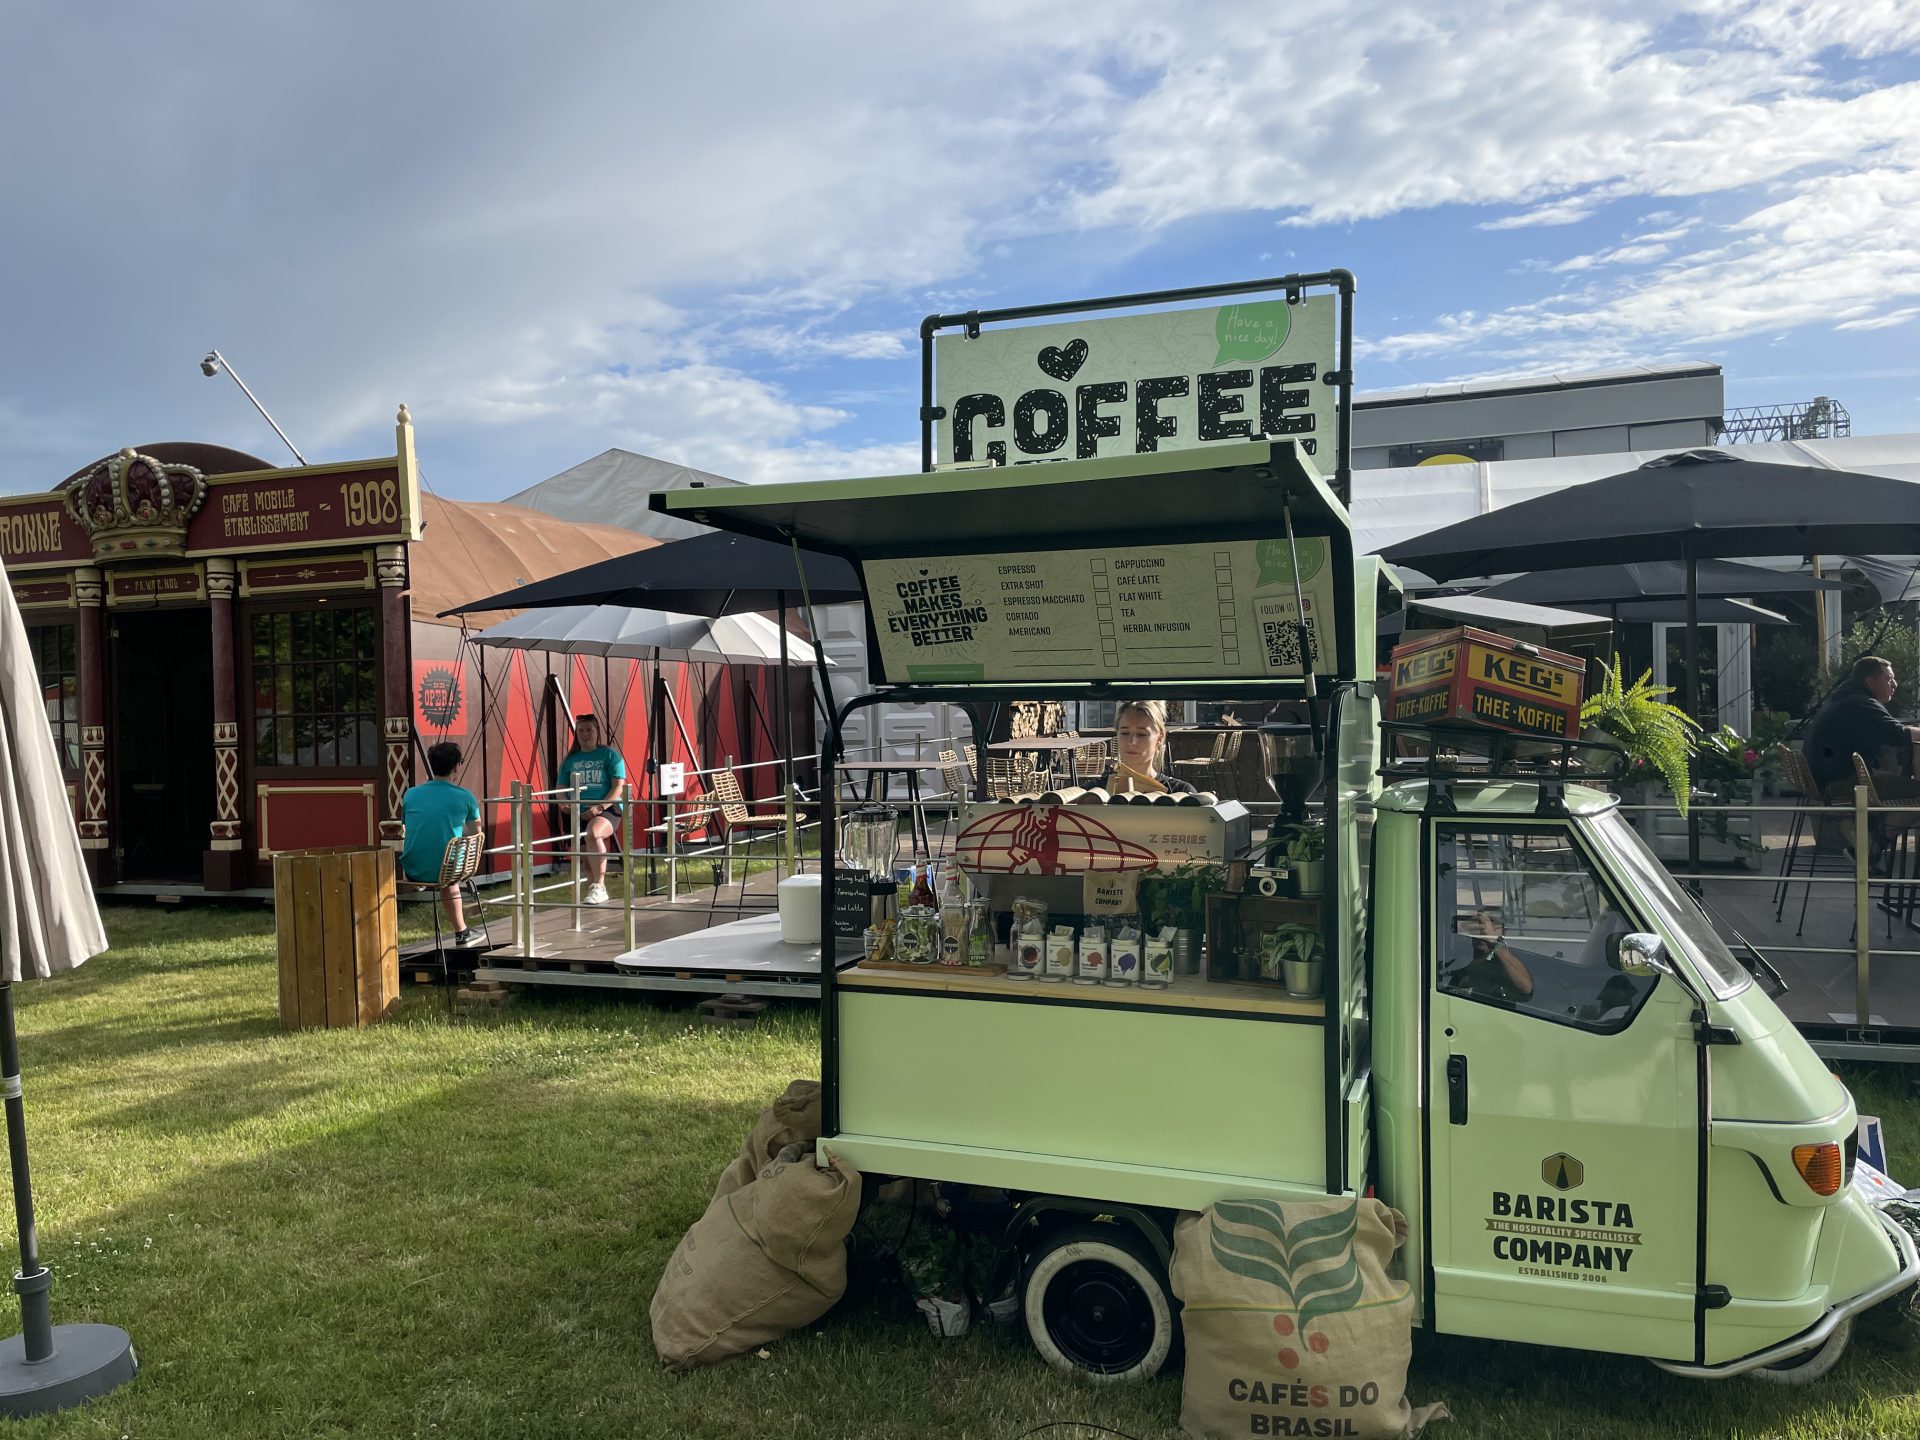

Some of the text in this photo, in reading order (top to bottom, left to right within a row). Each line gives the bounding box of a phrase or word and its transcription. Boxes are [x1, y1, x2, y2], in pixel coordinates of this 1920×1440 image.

[1227, 305, 1274, 329] Have a
[1225, 327, 1278, 350] nice day!
[953, 362, 1316, 468] COFFEE
[222, 488, 295, 514] CAFÉ MOBILE
[340, 479, 398, 527] 1908
[223, 511, 310, 537] ÉTABLISSEMENT
[1266, 539, 1293, 557] Hav
[998, 564, 1036, 575] ESPRESSO
[1115, 558, 1165, 570] CAPPUCCINO
[896, 575, 960, 599] COFFEE
[1001, 580, 1044, 590] EXTRA SHOT
[1117, 575, 1160, 586] CAFÉ LATTE
[903, 593, 963, 614] MAKES
[1003, 594, 1085, 606] ESPRESSO MACCHIATO
[1119, 591, 1163, 602] FLAT WHITE
[1006, 611, 1039, 621] CORTADO
[1120, 608, 1136, 618] TEA
[1260, 602, 1295, 615] FOLLOW US
[888, 607, 988, 633] EVERYTHING
[1123, 622, 1190, 633] HERBAL INFUSION
[911, 626, 974, 647] BETTER
[1008, 627, 1051, 636] AMERICANO
[1396, 648, 1455, 687] KEG's
[1484, 653, 1564, 690] KEG's
[424, 689, 455, 707] OPERA
[1395, 691, 1449, 720] THEE-KOFFIE
[573, 769, 602, 784] REW
[1148, 834, 1207, 845] Z SERIES
[1492, 1191, 1633, 1228] BARISTA
[1493, 1221, 1634, 1243] THE HOSPITALITY SPECIALISTS
[1493, 1236, 1633, 1273] COMPANY
[1518, 1266, 1607, 1284] ESTABLISHED 2006
[1228, 1378, 1380, 1408] CAFÉS DO
[1251, 1413, 1360, 1438] BRASIL
